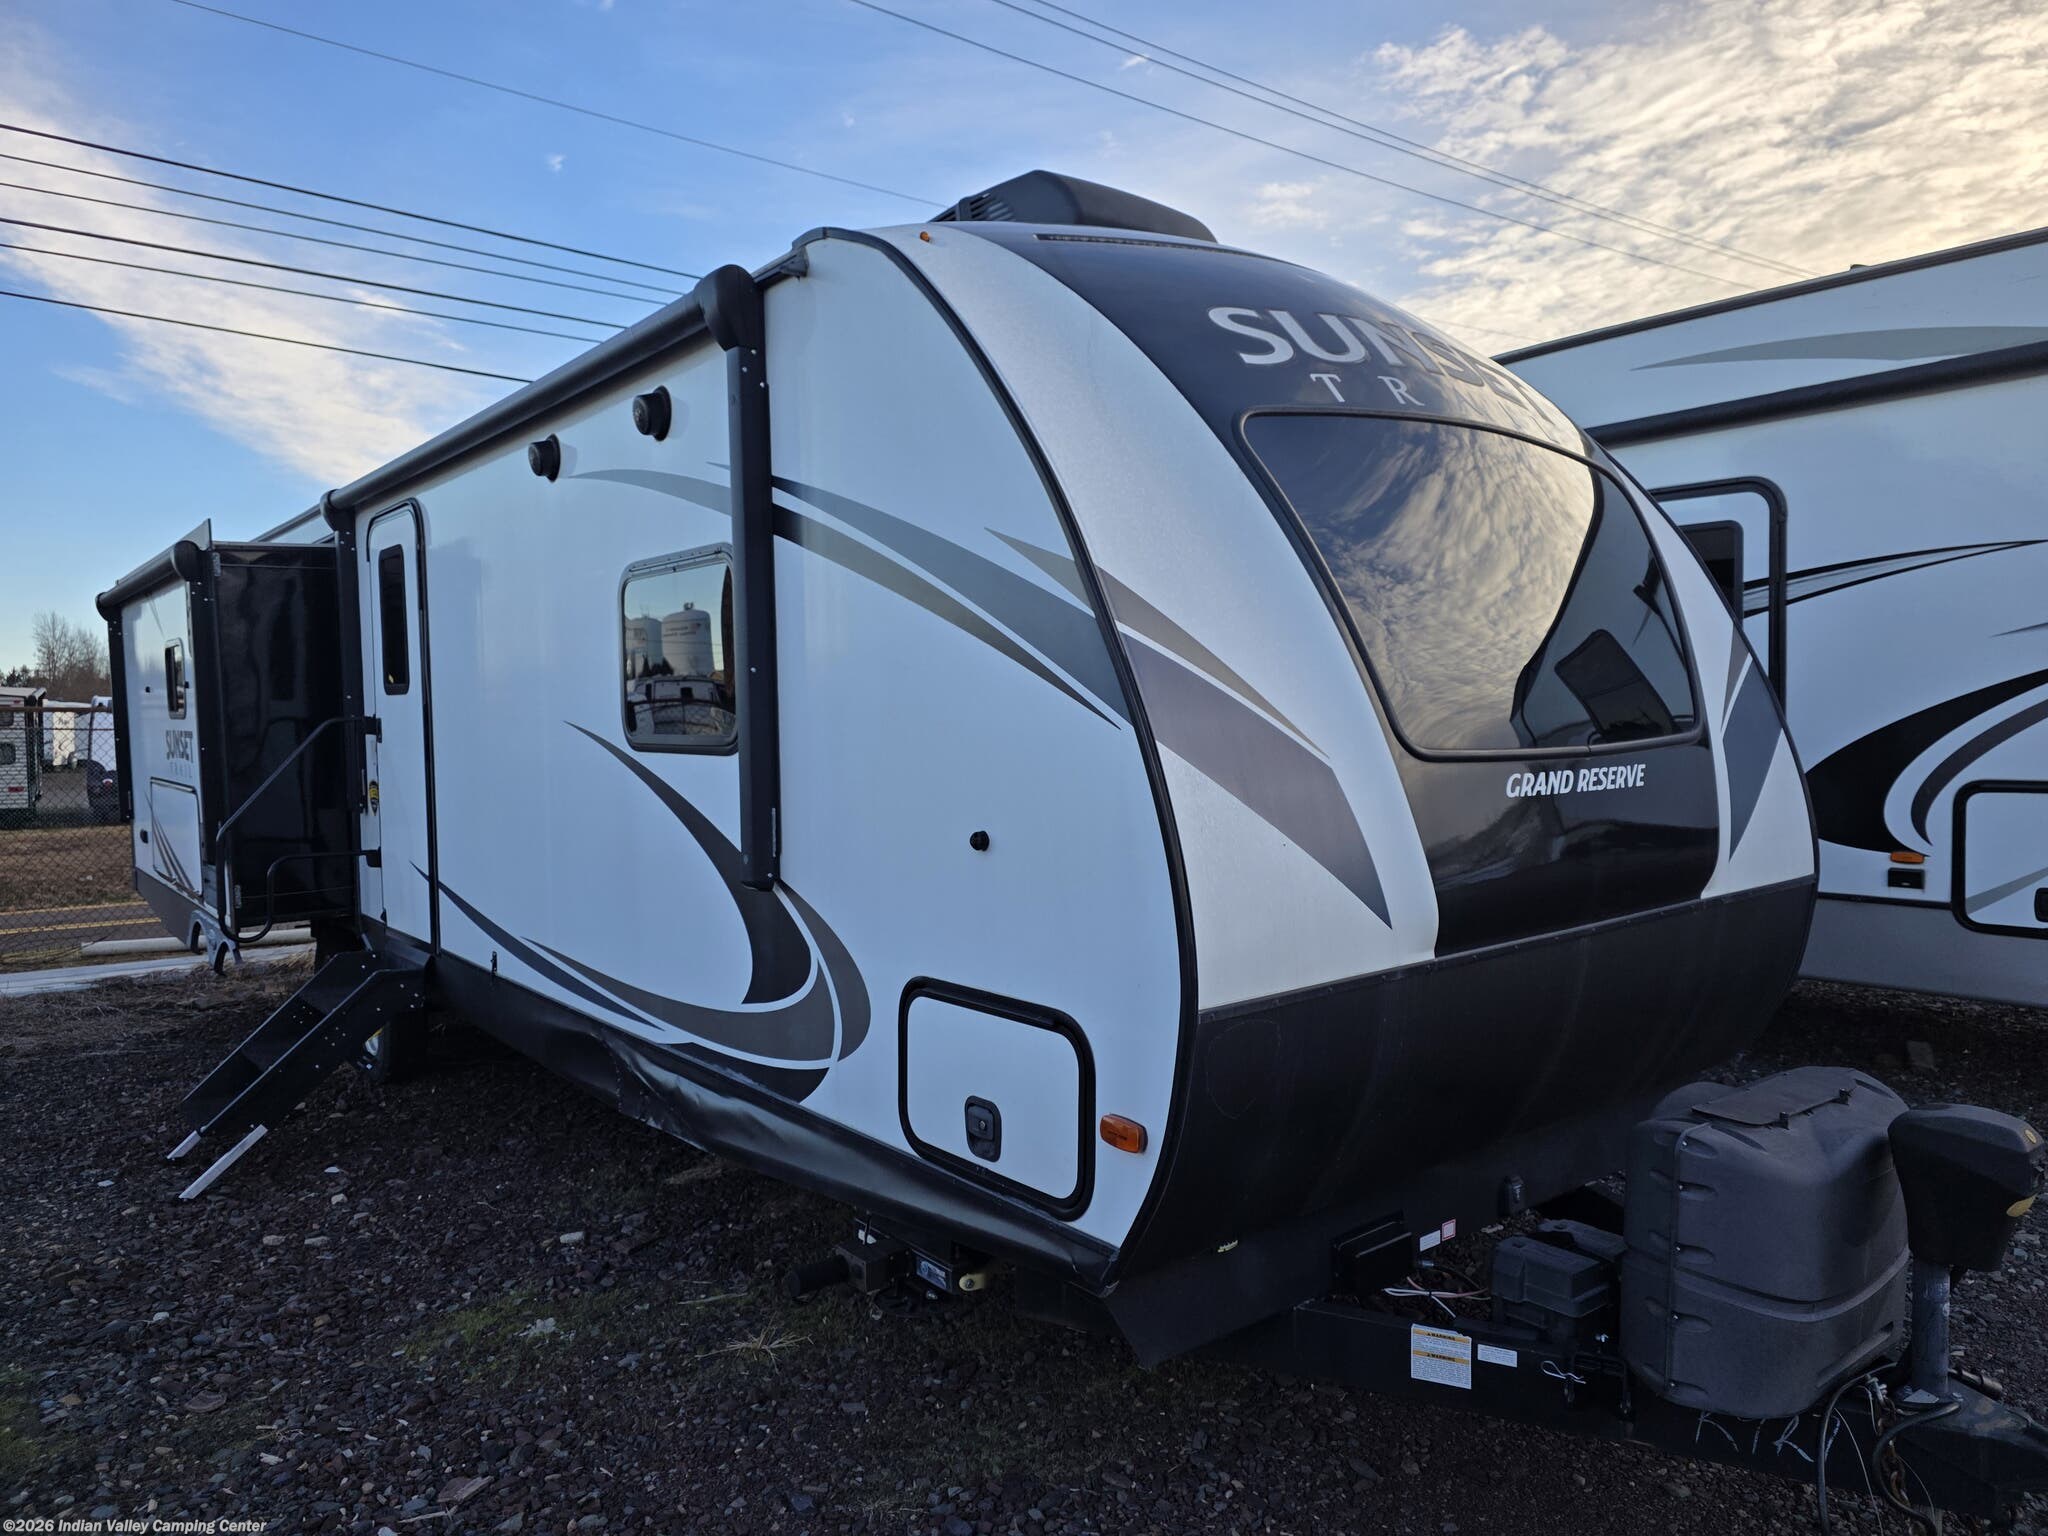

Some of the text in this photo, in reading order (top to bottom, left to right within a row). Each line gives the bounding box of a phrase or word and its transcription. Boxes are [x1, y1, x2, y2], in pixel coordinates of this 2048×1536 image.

[165, 729, 194, 764] SUNSET
[1505, 763, 1647, 798] GRAND RESERVE
